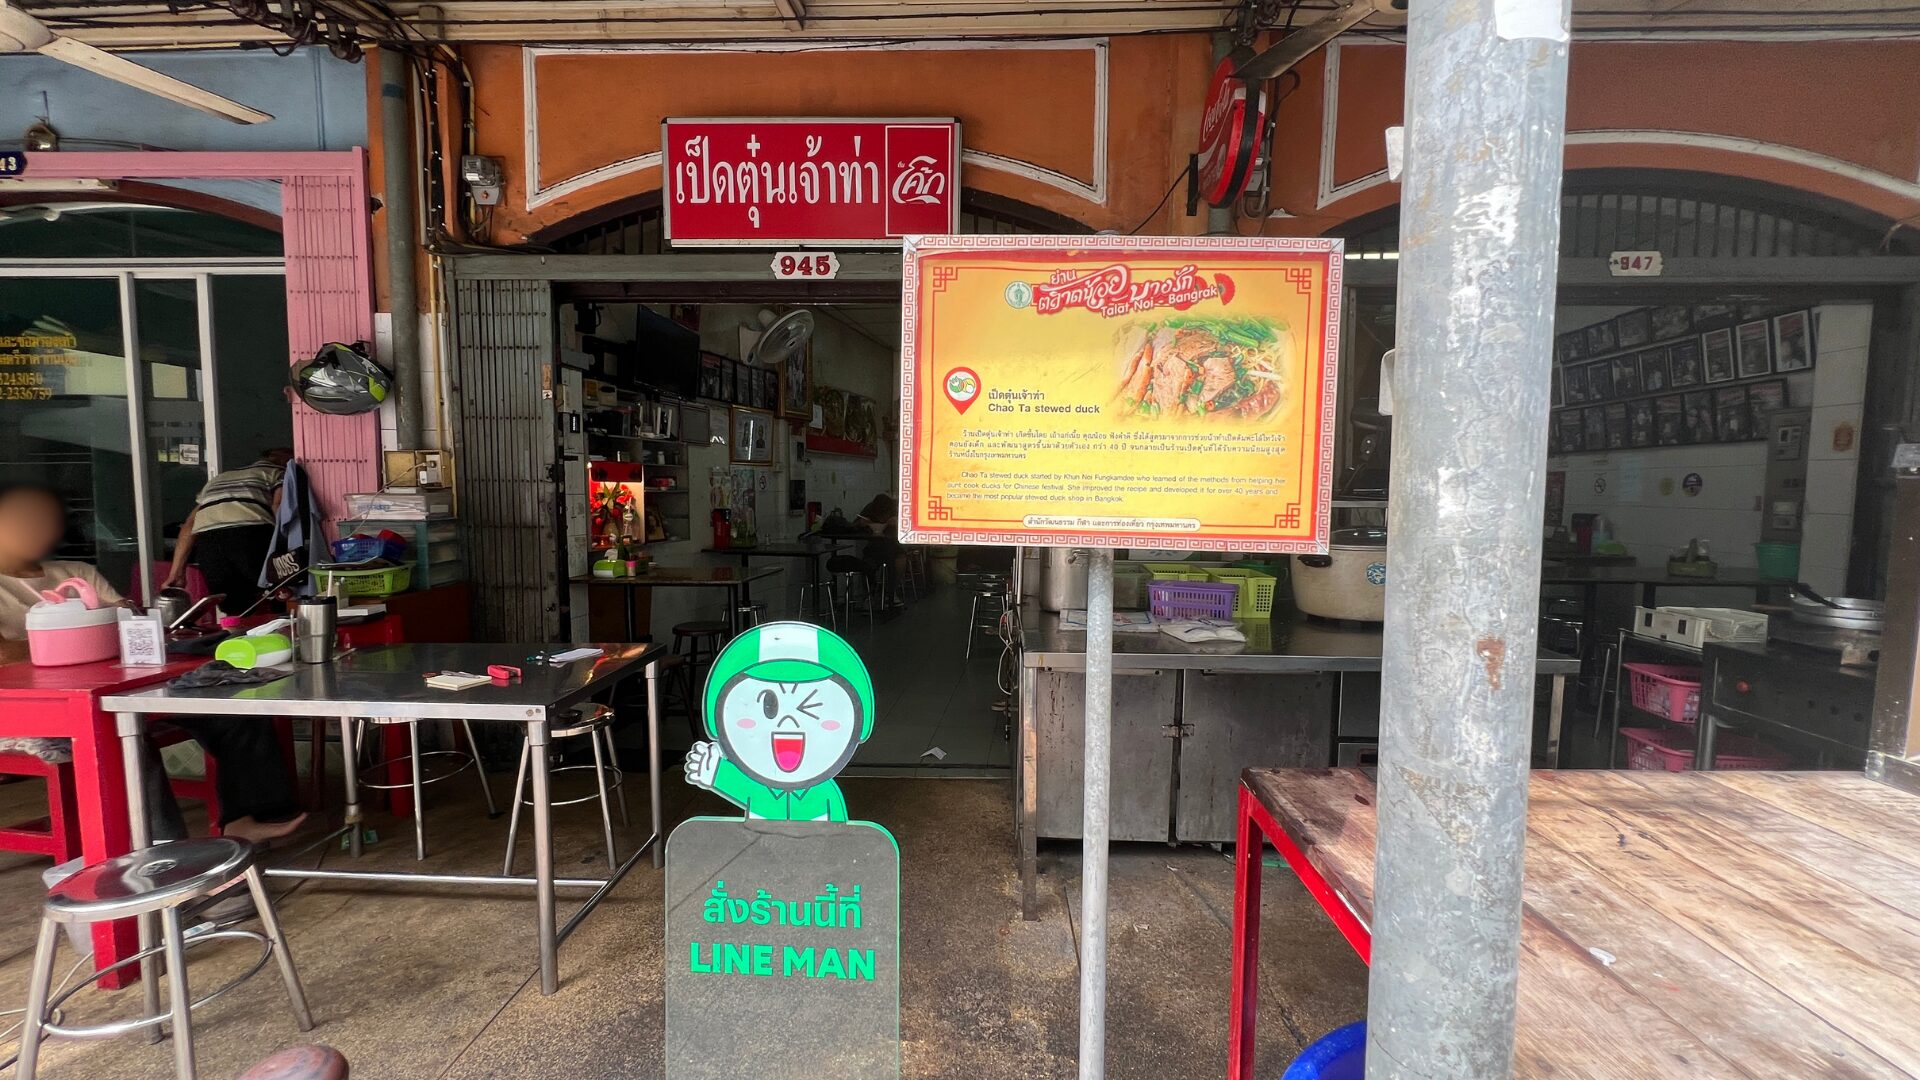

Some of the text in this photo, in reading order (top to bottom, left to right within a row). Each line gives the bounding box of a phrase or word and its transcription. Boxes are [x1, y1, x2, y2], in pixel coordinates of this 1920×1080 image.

[676, 134, 879, 229] เป็ดตุ๋นเจ้าท่า
[780, 255, 831, 276] 945
[1620, 255, 1654, 271] 947
[1051, 268, 1077, 285] ย่าน
[1133, 298, 1155, 311] Noi
[1168, 286, 1218, 305] Bangrak
[988, 388, 1045, 404] เป็ดตุ๋นเจ้าท่า
[988, 403, 1100, 414] Chao Ta stewed duck
[1030, 472, 1052, 480] started
[1054, 473, 1062, 481] by
[1231, 476, 1246, 484] from
[703, 880, 861, 929] สั่งร้านนี้ที่
[690, 942, 876, 981] LINE MAN
